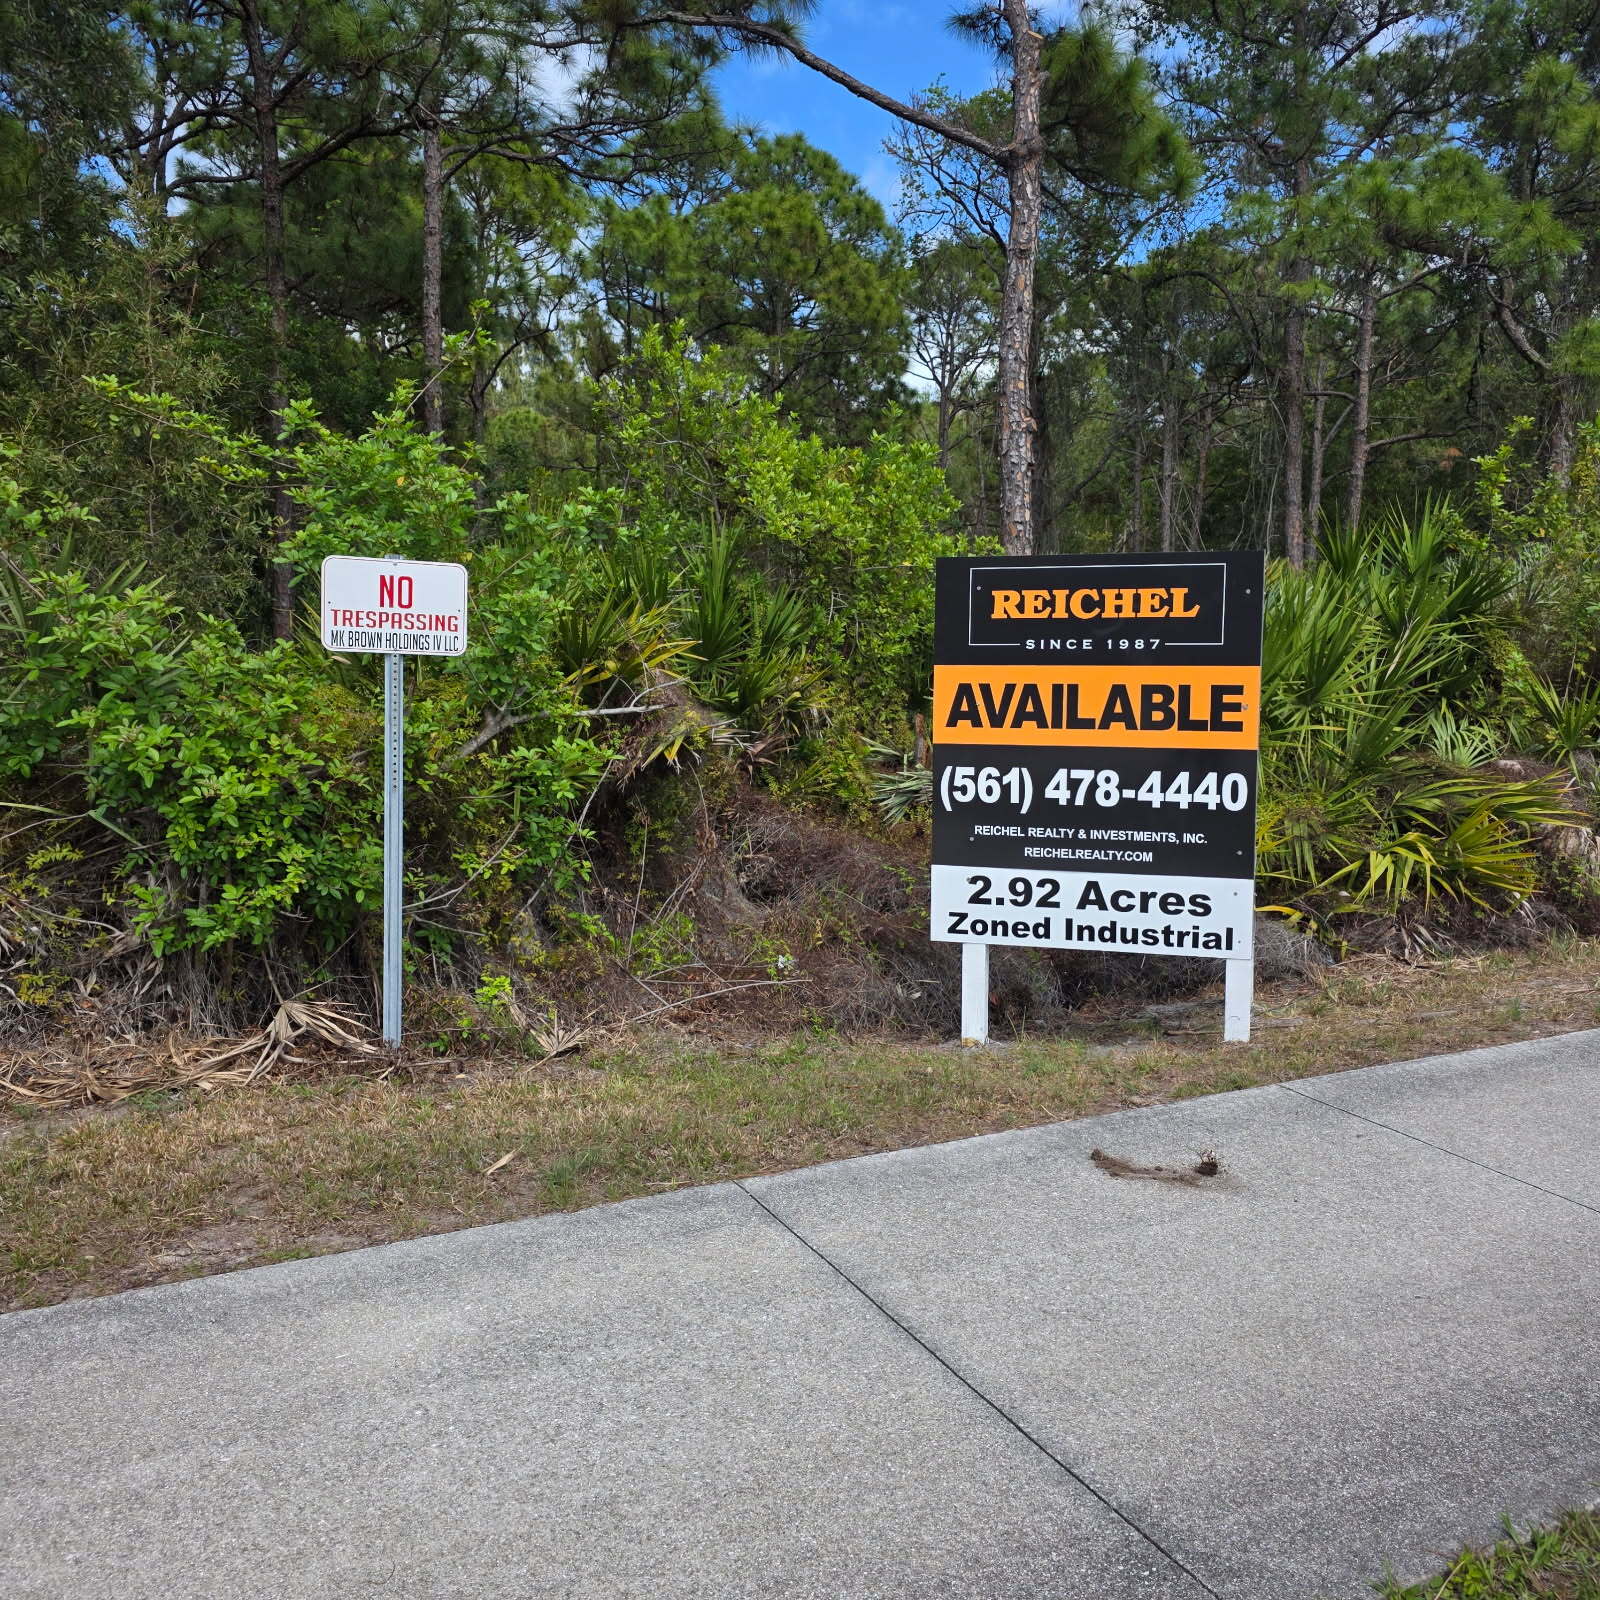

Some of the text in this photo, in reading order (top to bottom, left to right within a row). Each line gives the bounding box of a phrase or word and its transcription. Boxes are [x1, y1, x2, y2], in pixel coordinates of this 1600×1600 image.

[379, 575, 413, 609] NO
[991, 588, 1200, 619] REICHEL
[331, 609, 458, 632] TRESPASSING
[331, 630, 459, 652] MK BROWN HOLDINGS IV LLC
[1025, 639, 1160, 650] SINCE 1987
[946, 683, 1245, 732] AVAILABLE
[940, 766, 1248, 814] (561) 478-4440
[974, 825, 1207, 844] REICHEL REALTY & INVESTMENTS, INC.
[1024, 847, 1153, 862] REICHELREALTY.COM
[967, 875, 1212, 917] 2.92 Acres
[947, 911, 1233, 951] Zoned Industrial
